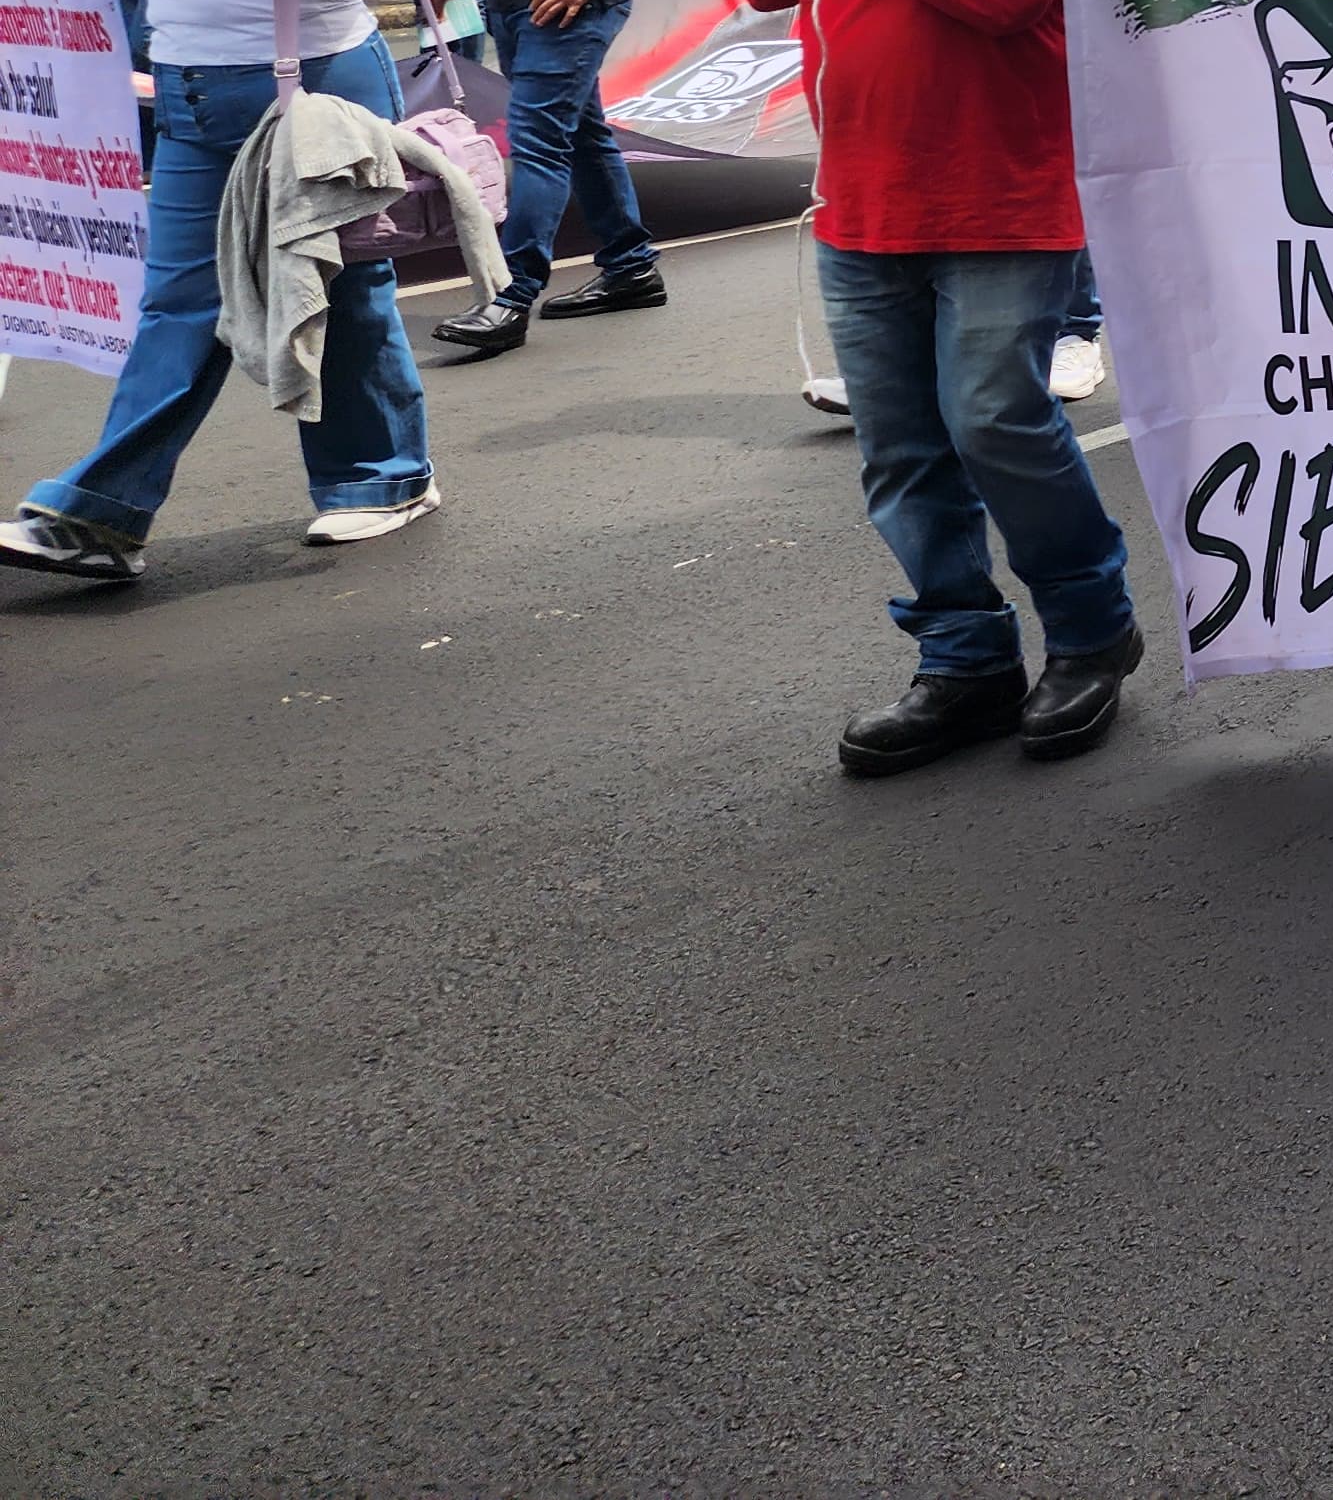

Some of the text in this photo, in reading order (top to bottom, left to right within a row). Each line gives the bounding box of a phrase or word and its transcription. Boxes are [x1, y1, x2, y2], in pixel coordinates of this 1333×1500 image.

[25, 61, 59, 118] salud
[3, 314, 51, 337] DIGNIDAD
[58, 324, 97, 348] JUSTICIA
